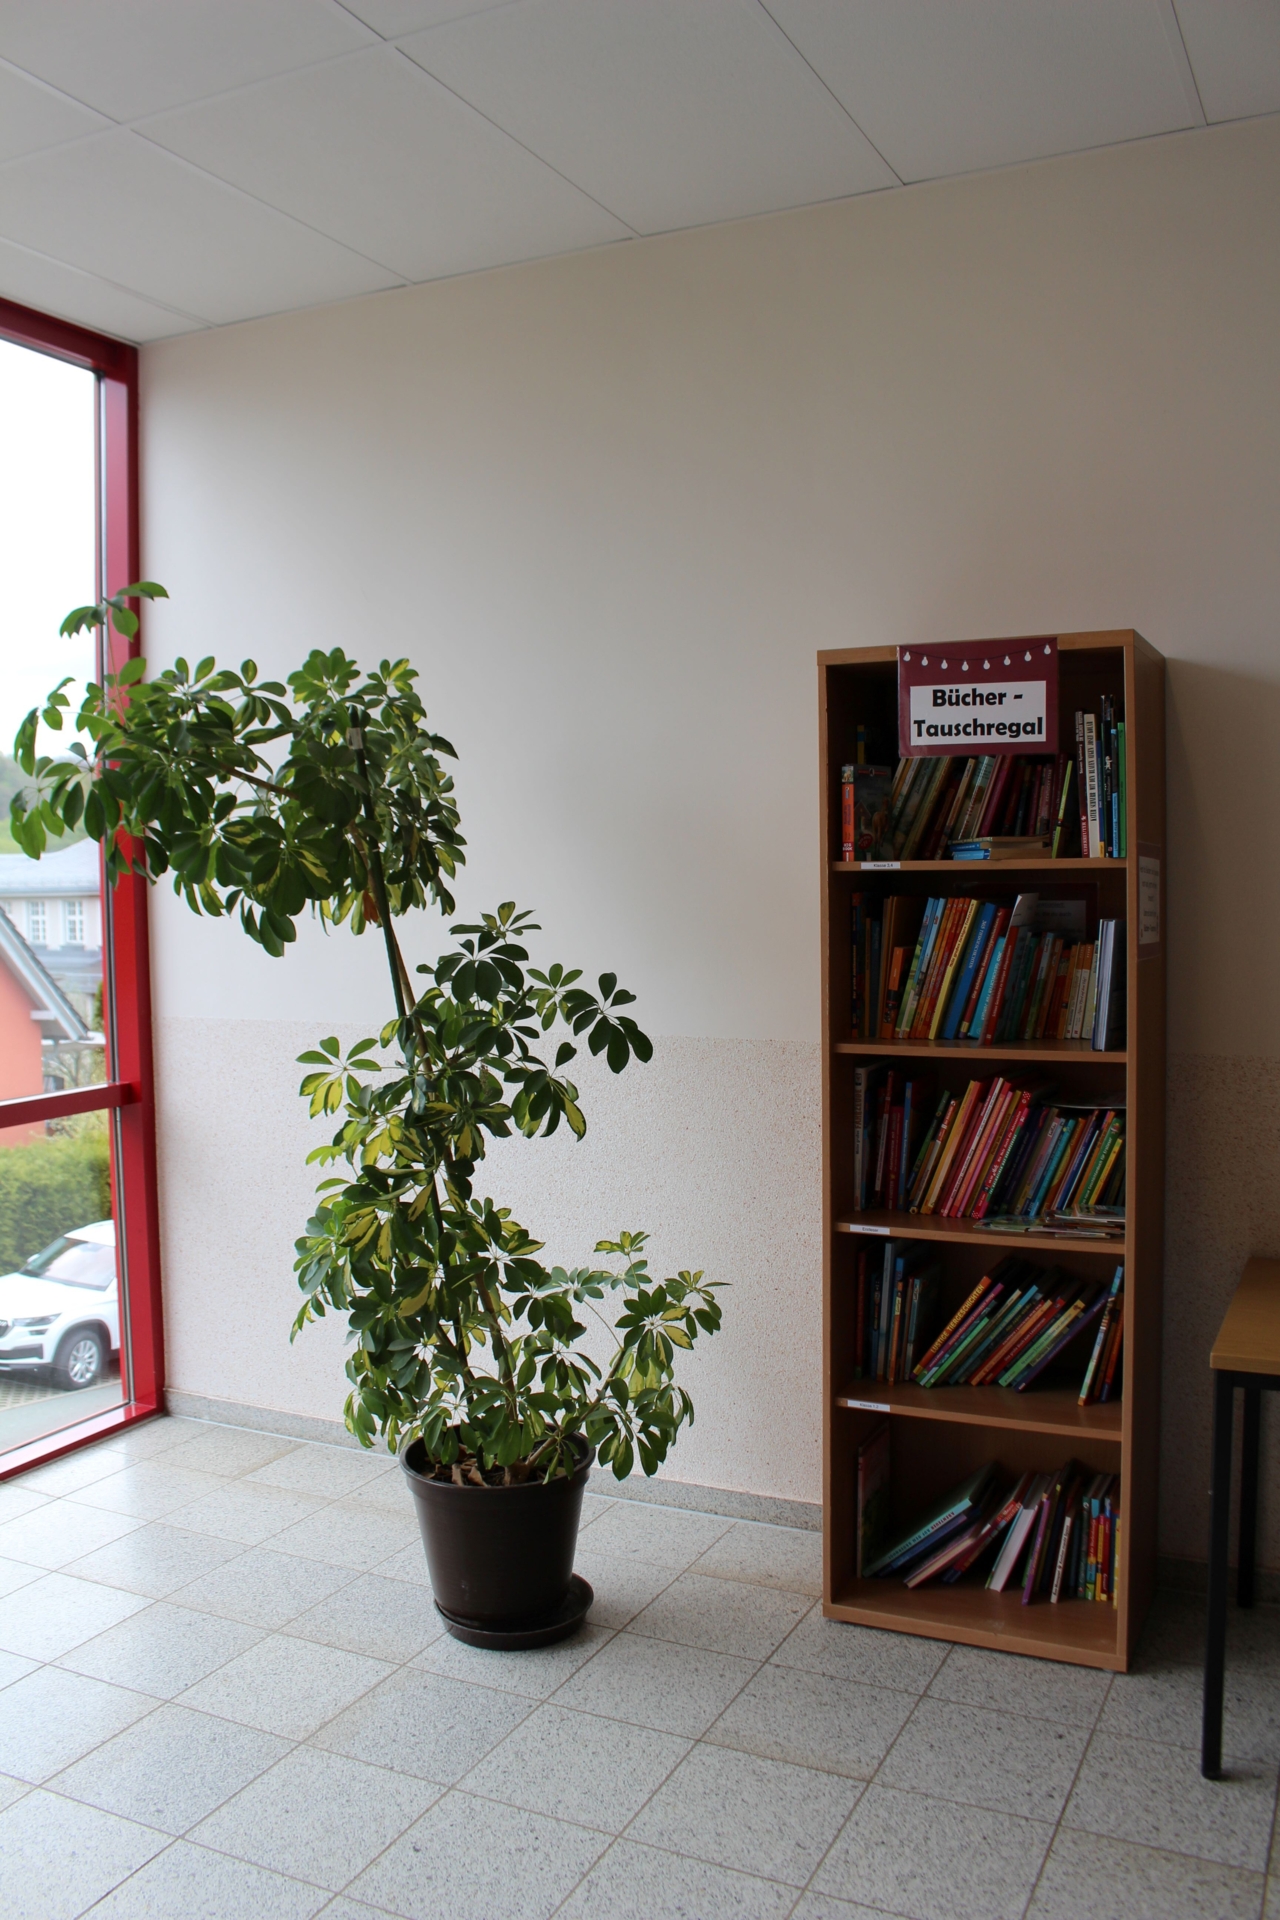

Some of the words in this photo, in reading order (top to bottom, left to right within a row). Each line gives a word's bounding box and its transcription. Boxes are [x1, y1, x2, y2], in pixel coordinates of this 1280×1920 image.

[933, 687, 1006, 707] Bücher
[914, 717, 1043, 739] Tauschregal
[929, 1330, 949, 1353] LUSTIGE
[945, 1284, 985, 1331] TIERGESCHICHTEN
[1016, 1338, 1025, 1348] Buch
[929, 1511, 955, 1530] ABENTEUER
[911, 1534, 921, 1543] DEM
[921, 1528, 930, 1536] AUF
